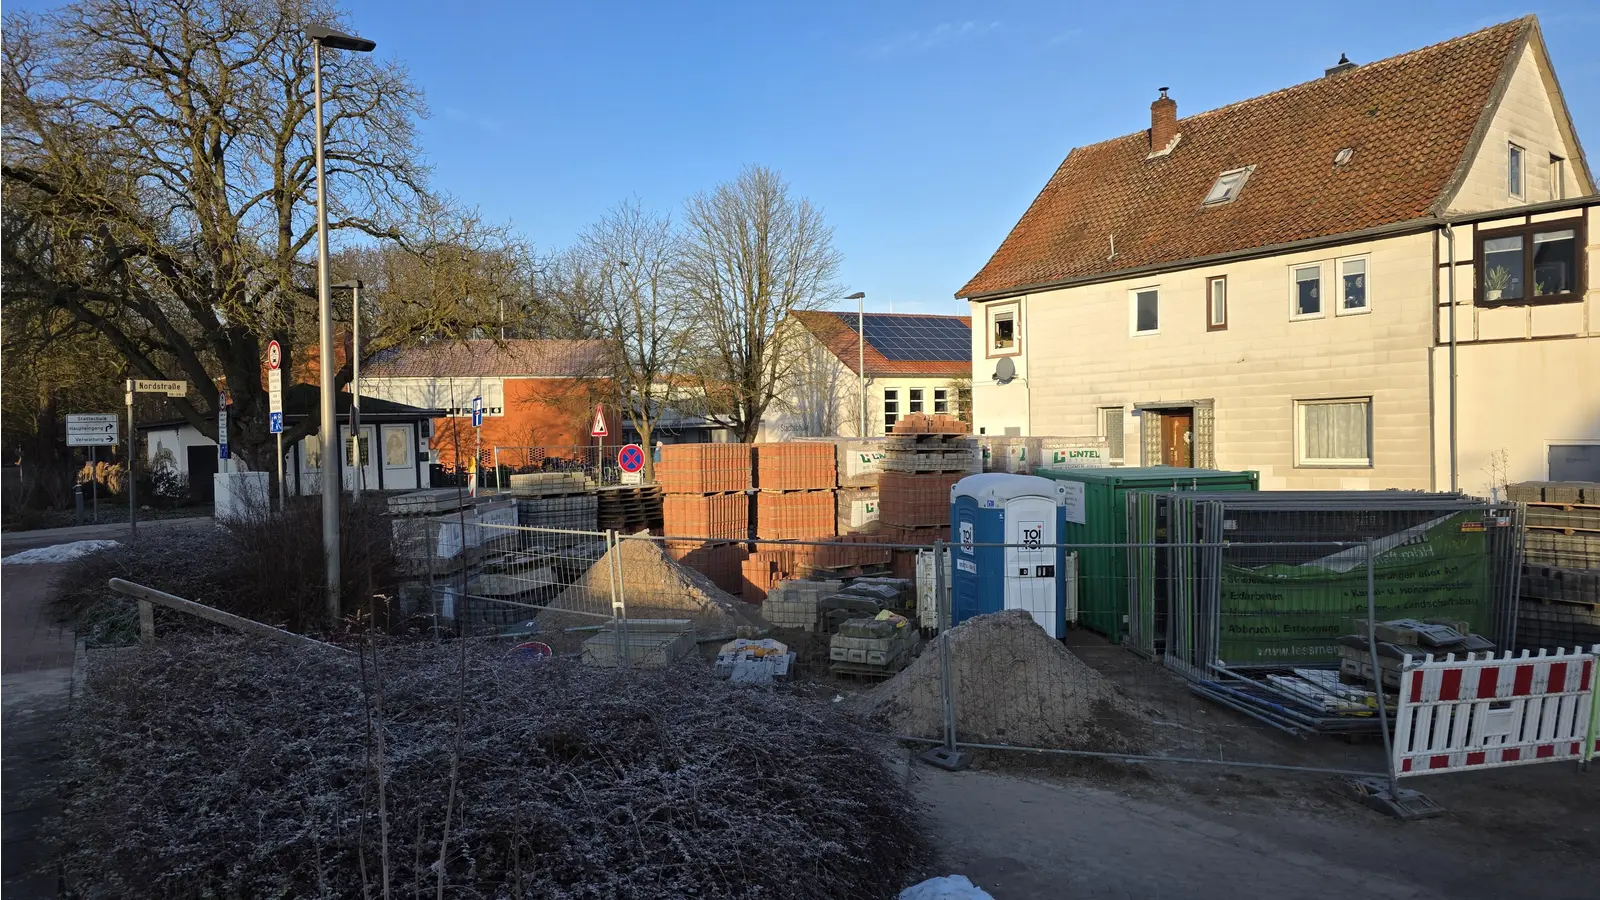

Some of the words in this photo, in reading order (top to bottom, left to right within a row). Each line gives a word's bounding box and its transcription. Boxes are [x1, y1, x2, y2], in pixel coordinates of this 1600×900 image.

[139, 382, 181, 390] Nordstraße
[1228, 623, 1270, 634] Abbruch
[1283, 623, 1340, 634] Entsorgung
